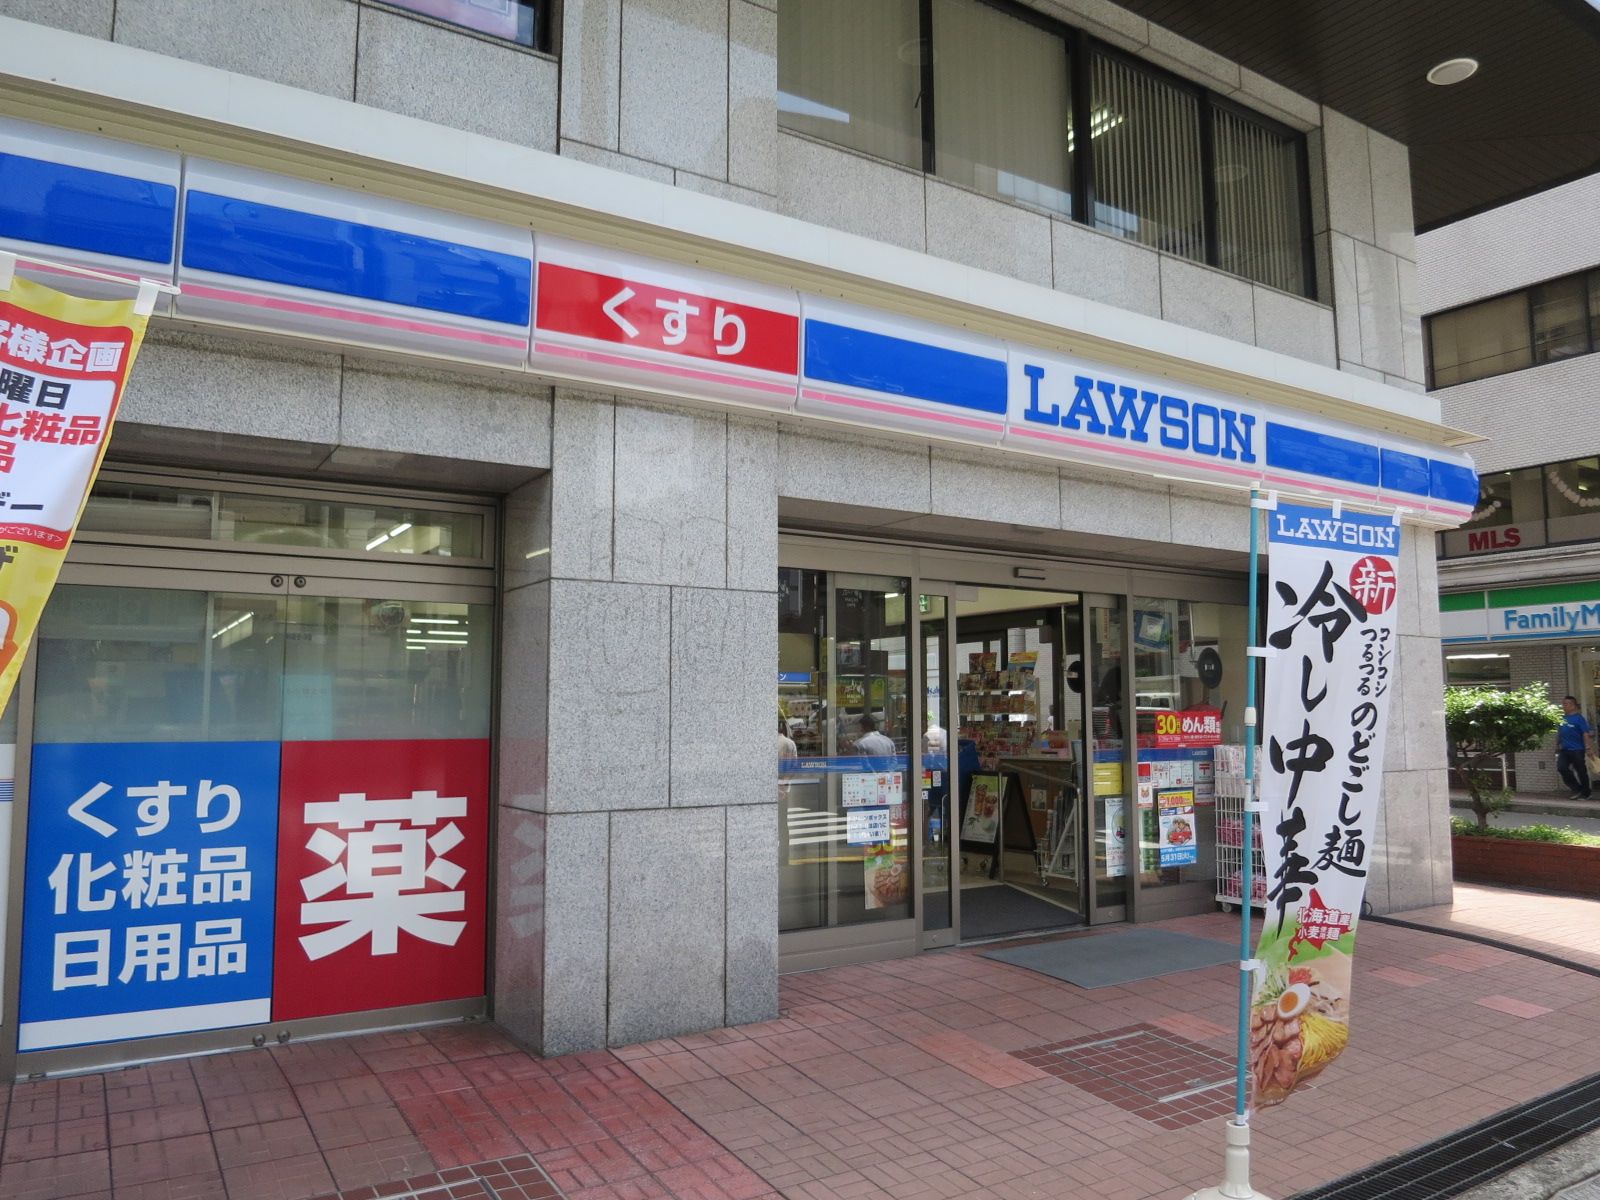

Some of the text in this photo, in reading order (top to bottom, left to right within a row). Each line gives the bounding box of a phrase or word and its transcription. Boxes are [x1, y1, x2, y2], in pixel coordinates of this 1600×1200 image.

[602, 287, 746, 356] くすり
[0, 368, 71, 410] 曜日
[1024, 364, 1256, 463] LAWSON
[1276, 515, 1395, 549] LAWSON
[1469, 528, 1521, 551] MLS
[1352, 559, 1395, 614] 新
[1504, 603, 1600, 632] FamilyM
[1357, 629, 1377, 696] つるつる
[1375, 628, 1391, 698] コシコシ
[1267, 560, 1367, 939] 冷し中華
[67, 779, 241, 838] くすり
[1311, 702, 1377, 878] のどごし麺
[48, 847, 252, 914] 化粧品
[298, 790, 468, 961] 薬
[1296, 907, 1352, 926] 北海道産
[53, 918, 247, 991] 日用品
